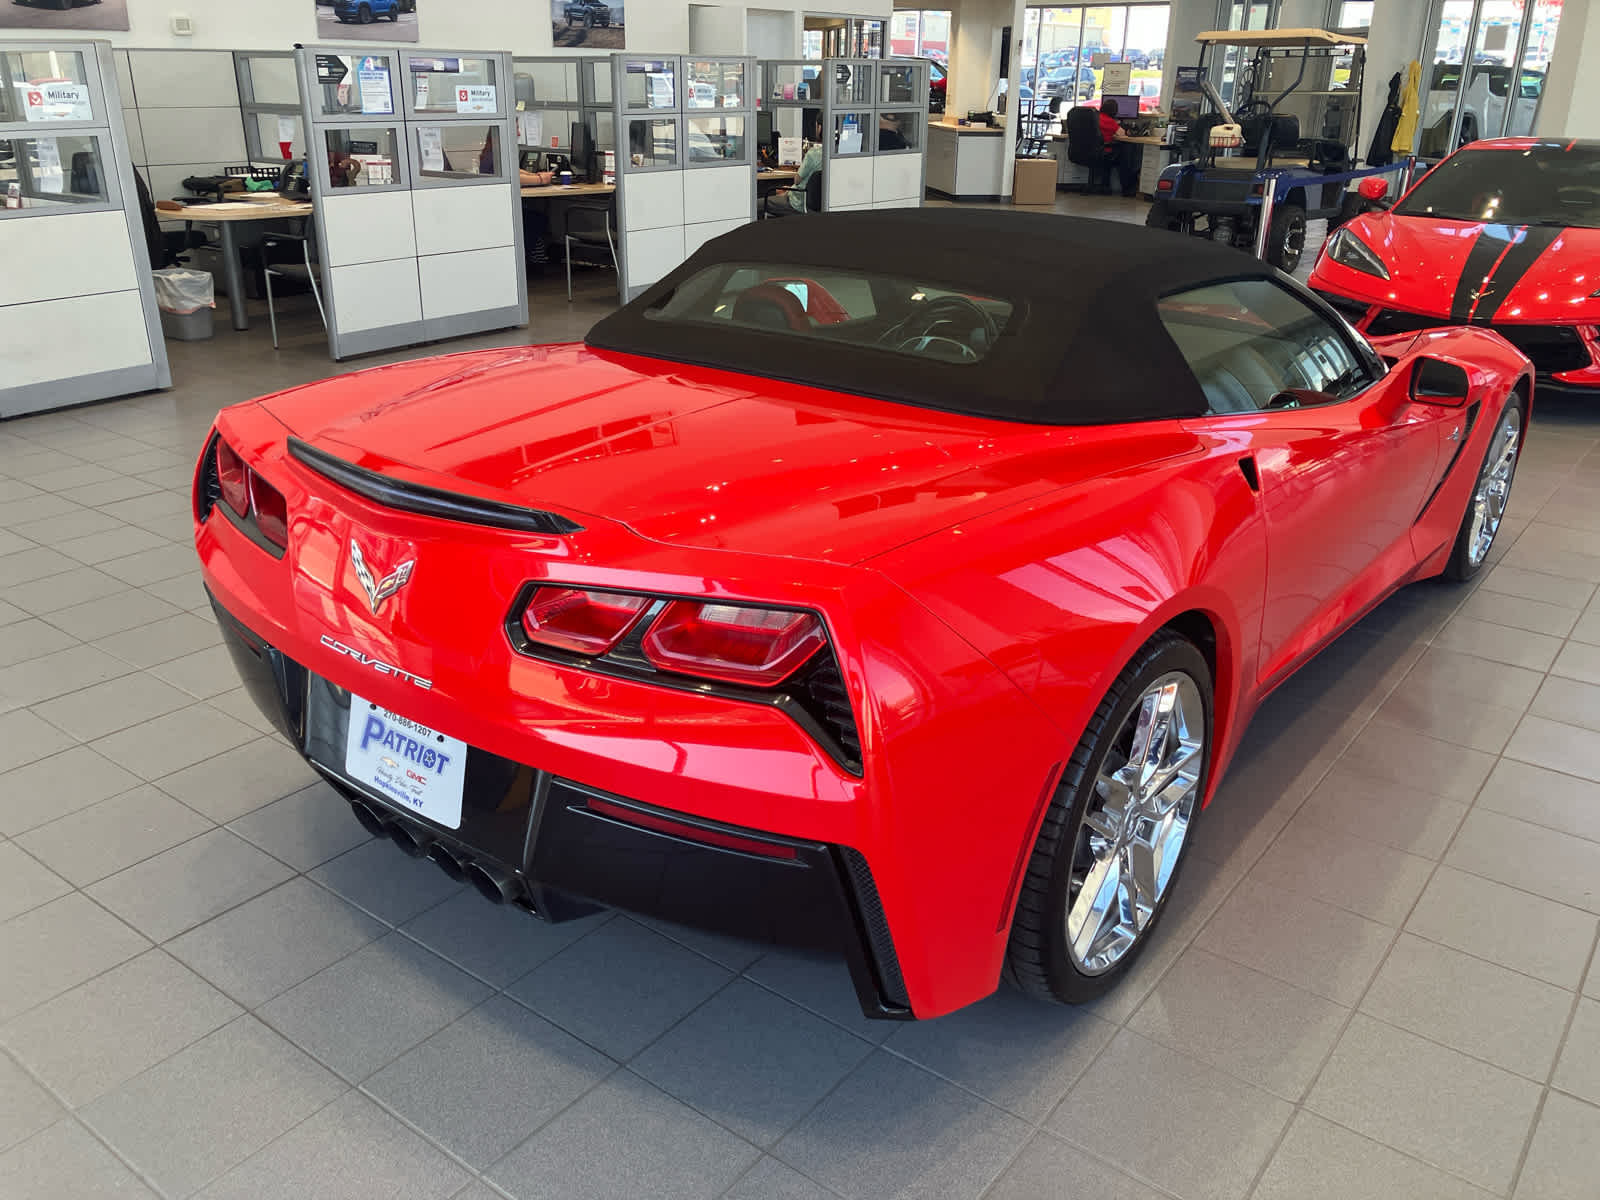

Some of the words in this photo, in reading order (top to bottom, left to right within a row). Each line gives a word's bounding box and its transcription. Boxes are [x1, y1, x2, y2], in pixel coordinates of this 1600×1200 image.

[48, 90, 80, 100] Military
[320, 634, 433, 690] CORVETTE
[360, 713, 450, 775] PATRIOT
[406, 768, 428, 786] GMC
[412, 797, 424, 809] KY
